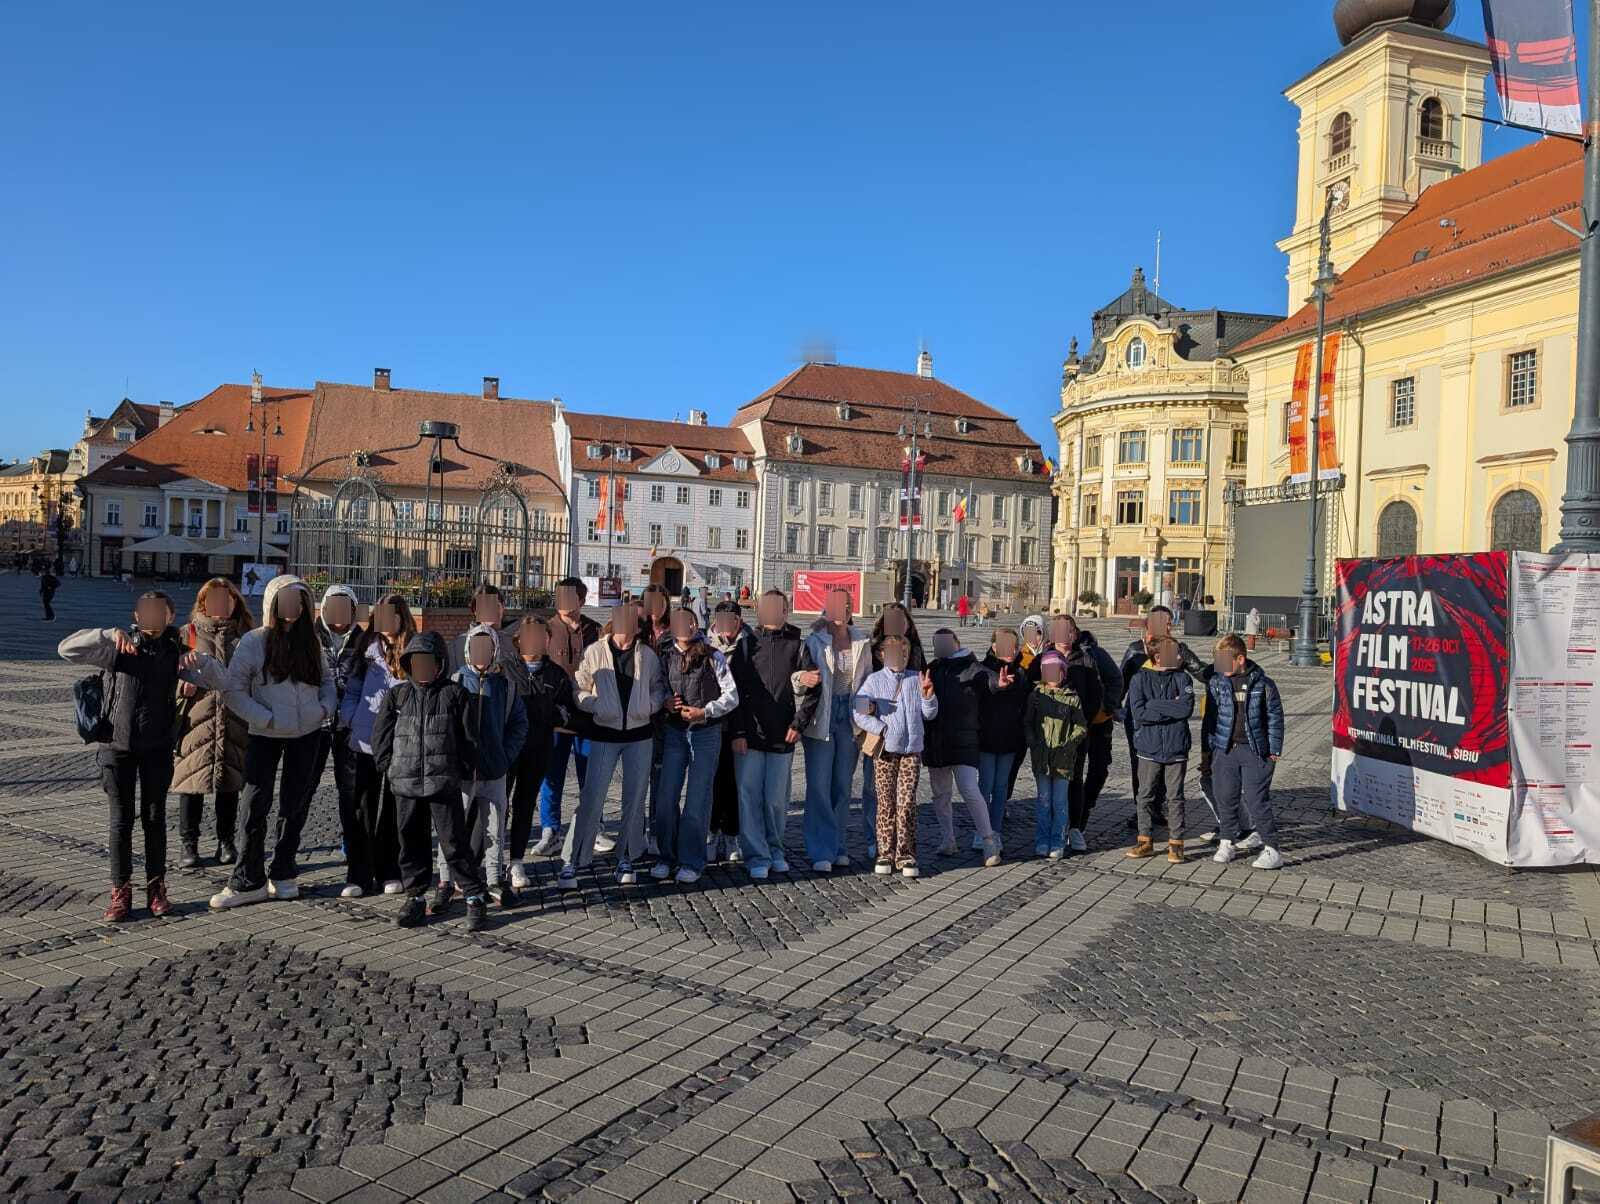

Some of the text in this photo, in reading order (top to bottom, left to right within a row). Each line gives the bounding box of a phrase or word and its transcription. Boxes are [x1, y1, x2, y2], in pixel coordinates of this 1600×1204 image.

[1361, 590, 1435, 627] ASTRA
[1356, 633, 1409, 671] FILM
[1442, 638, 1460, 655] OCT
[1410, 656, 1437, 672] 2025
[1353, 676, 1466, 725] FESTIVAL
[1453, 747, 1480, 764] SIBIU
